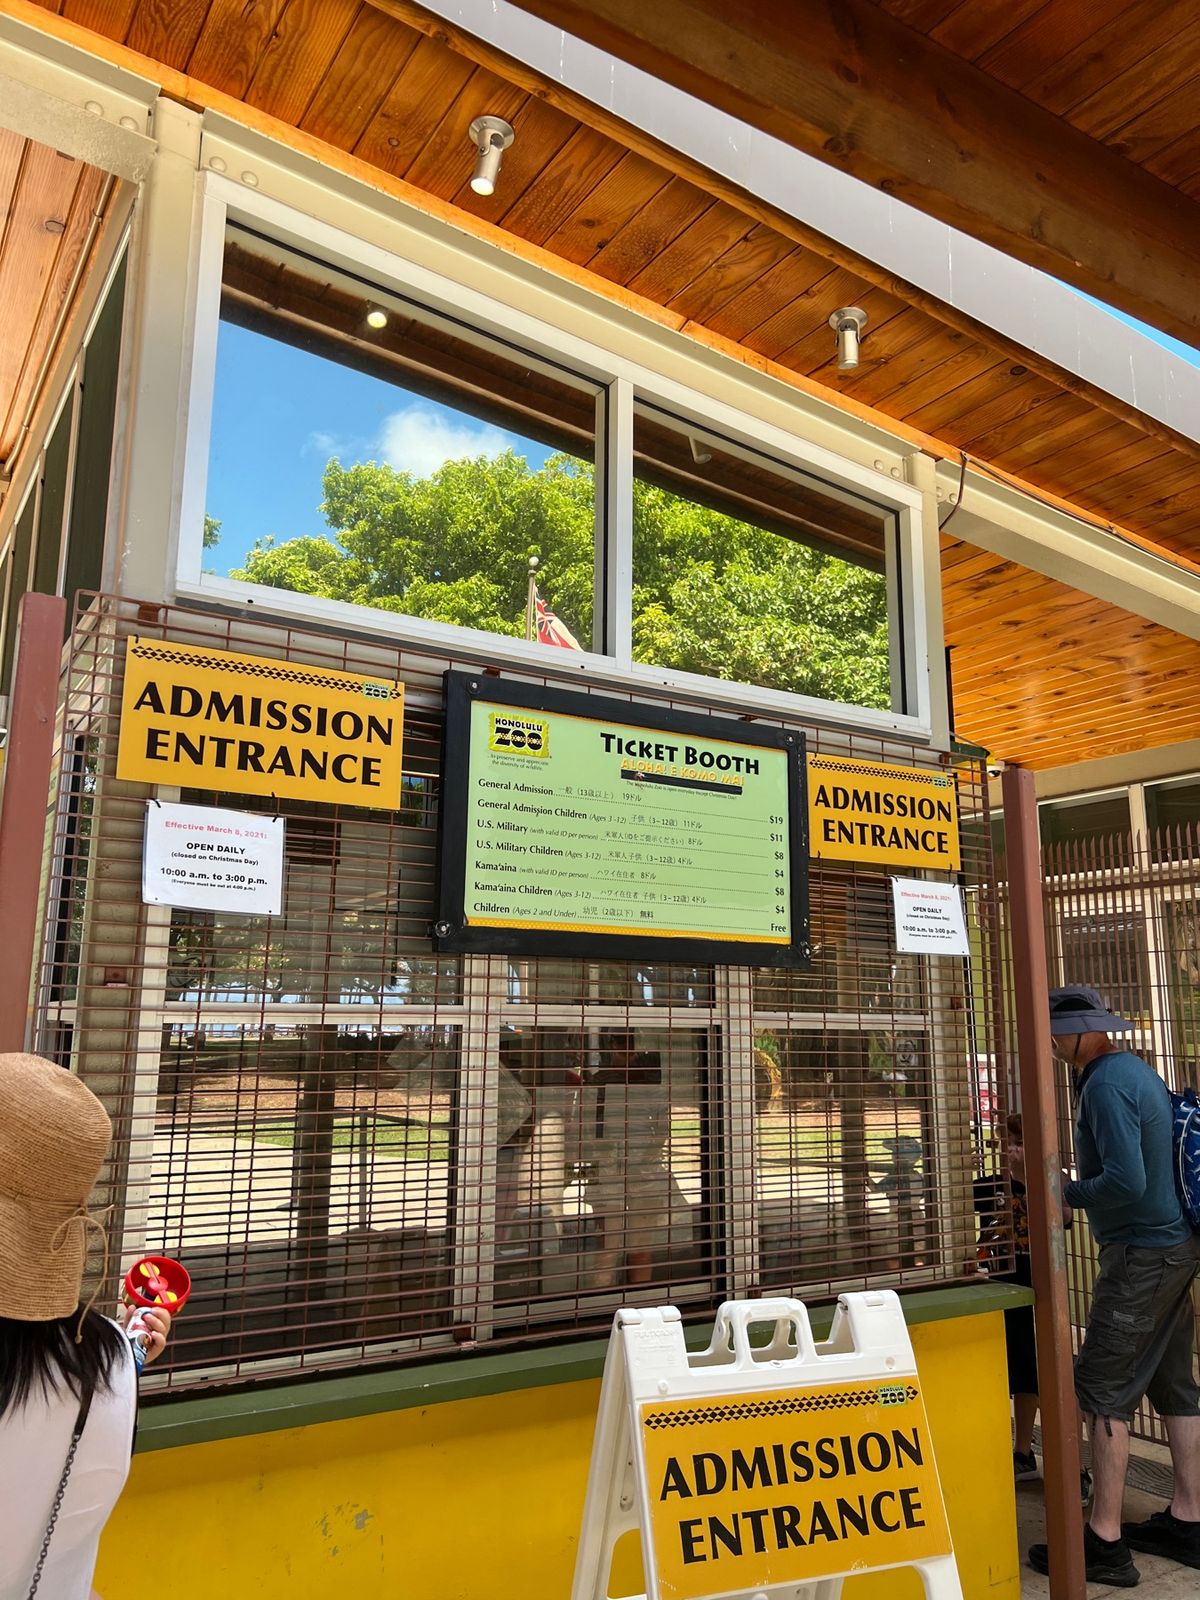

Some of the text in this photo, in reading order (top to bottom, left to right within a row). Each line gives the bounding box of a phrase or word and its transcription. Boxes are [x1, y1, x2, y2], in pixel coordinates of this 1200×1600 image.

[133, 681, 393, 746] ADMISSION
[495, 718, 542, 732] HONOLULU
[495, 726, 543, 751] ZOO
[145, 727, 382, 787] ENTRANCE
[600, 732, 759, 775] TICKET BOOTH
[680, 767, 717, 781] KOMO
[478, 778, 553, 796] General Admission
[477, 798, 510, 810] General
[512, 802, 552, 815] Admission
[555, 807, 587, 819] Children
[590, 813, 606, 823] (Ages
[814, 784, 952, 822] ADMISSION
[165, 821, 204, 831] Effective
[207, 825, 233, 834] March
[477, 818, 494, 829] U.S.
[496, 821, 528, 835] Military
[545, 828, 559, 836] valid
[568, 831, 577, 839] per
[769, 815, 784, 825] $19
[770, 832, 783, 842] $11
[823, 818, 949, 854] ENTRANCE
[186, 842, 246, 855] OPEN DAILY
[476, 839, 601, 860] U.S. Military Children (Ages 3-12)
[774, 850, 784, 860] $8
[171, 851, 197, 859] (closed
[208, 855, 243, 864] Christmas
[244, 858, 259, 866] Day)
[160, 867, 186, 877] 10:00
[225, 874, 245, 883] 3:00
[247, 876, 268, 885] p.m.
[475, 860, 517, 872] Kama'aina
[535, 868, 549, 876] valid
[558, 870, 568, 878] per
[568, 871, 589, 879] person)
[774, 869, 784, 878] $4
[474, 881, 592, 900] Kama'aina Children (Ages 3-12)
[775, 887, 785, 896] $8
[473, 902, 577, 919] Children (Ages 2 and Under)
[775, 905, 785, 914] $4
[770, 923, 787, 932] Free
[881, 1391, 905, 1404] ZOO
[660, 1427, 924, 1501] ADMISSION
[678, 1486, 925, 1565] ENTRANCE
